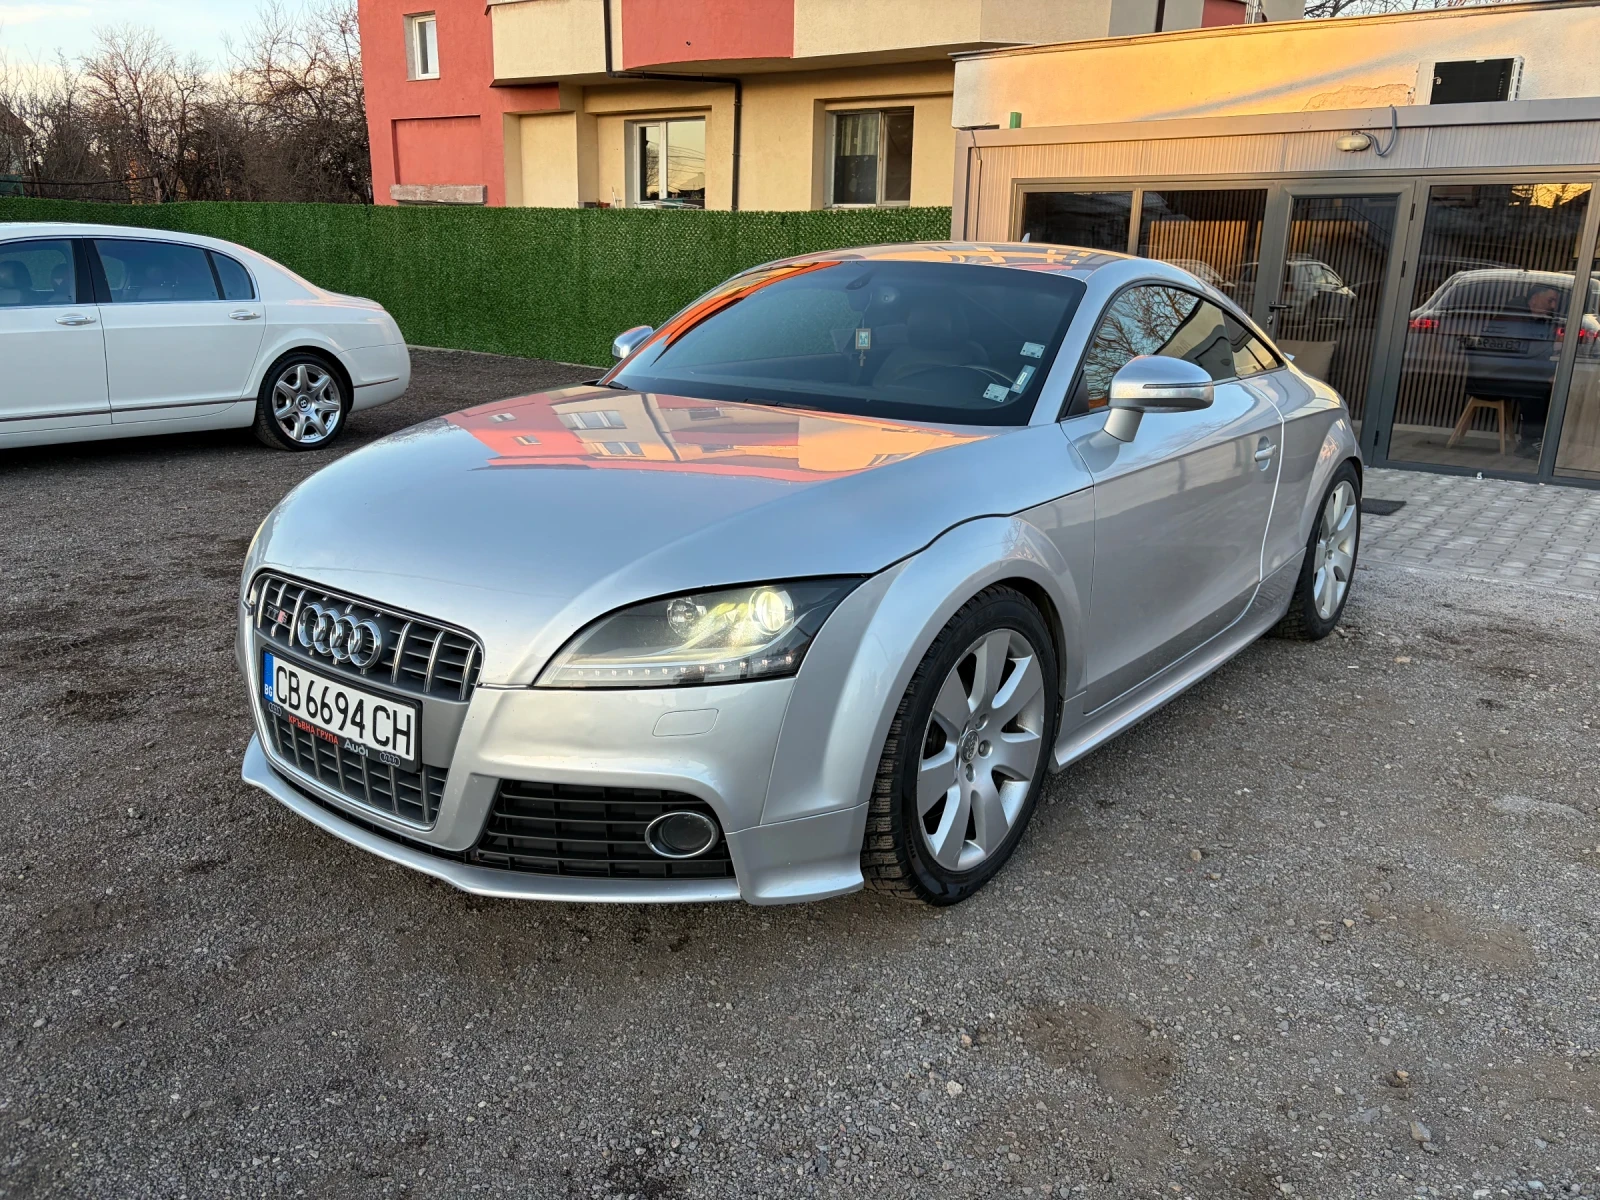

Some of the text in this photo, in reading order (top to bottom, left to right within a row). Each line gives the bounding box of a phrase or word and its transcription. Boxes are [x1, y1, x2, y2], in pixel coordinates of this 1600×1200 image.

[264, 684, 273, 697] BG
[276, 666, 411, 756] CB 6694 CH
[288, 714, 339, 745] КРЪВНА ГРУПА
[344, 739, 369, 757] Audi
